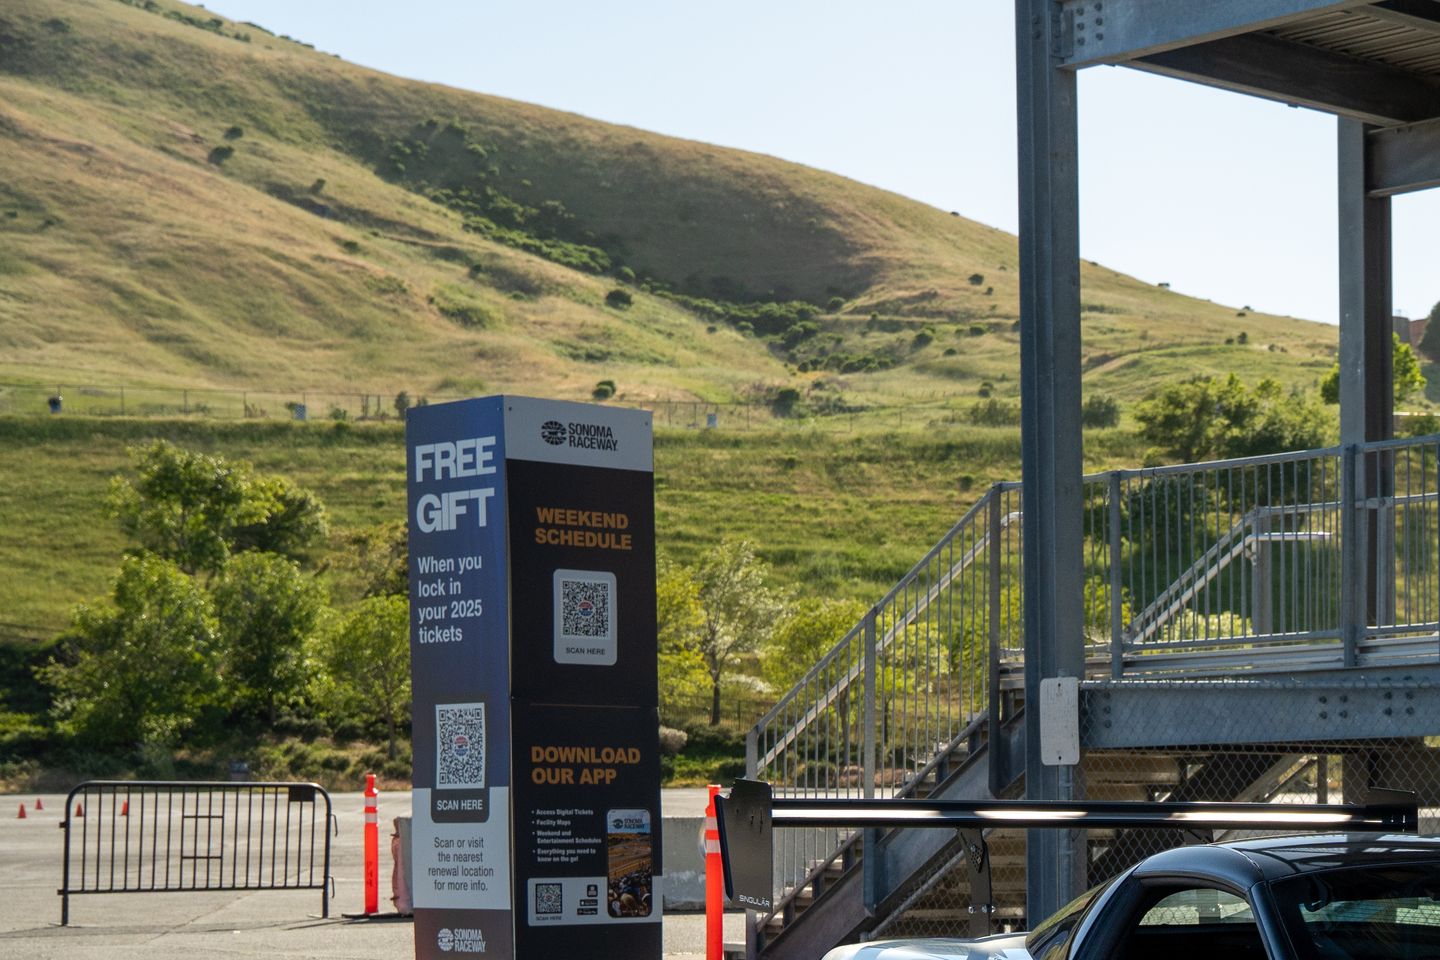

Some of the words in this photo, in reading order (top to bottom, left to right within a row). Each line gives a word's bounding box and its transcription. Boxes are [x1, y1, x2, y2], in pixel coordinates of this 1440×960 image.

[568, 423, 612, 439] SONOMA
[568, 435, 618, 451] RACEWAY
[415, 436, 496, 482] FREE
[416, 487, 495, 533] GIFT
[536, 507, 629, 529] WEEKEND
[535, 527, 632, 550] SCHEDULE
[417, 557, 454, 574] When
[458, 556, 482, 574] you
[418, 578, 446, 598] lock
[449, 580, 461, 595] in
[418, 604, 447, 624] your
[451, 599, 482, 619] 2025
[418, 626, 463, 644] tickets
[565, 647, 585, 655] SCAN
[586, 648, 606, 656] HERE
[531, 746, 641, 764] DOWNLOAD
[531, 768, 574, 785] OUR
[579, 768, 617, 785] APP
[436, 800, 458, 811] SCAN
[461, 799, 483, 811] HERE
[434, 837, 455, 848] Scan
[456, 839, 465, 848] or
[467, 837, 484, 848] visit
[437, 852, 451, 863] the
[453, 852, 483, 862] nearest
[428, 866, 459, 877] renewal
[461, 865, 494, 877] location
[433, 880, 446, 892] for
[447, 882, 468, 891] more
[470, 879, 488, 891] info.
[454, 928, 483, 941] SONOMA
[454, 940, 487, 953] RACEWAY
